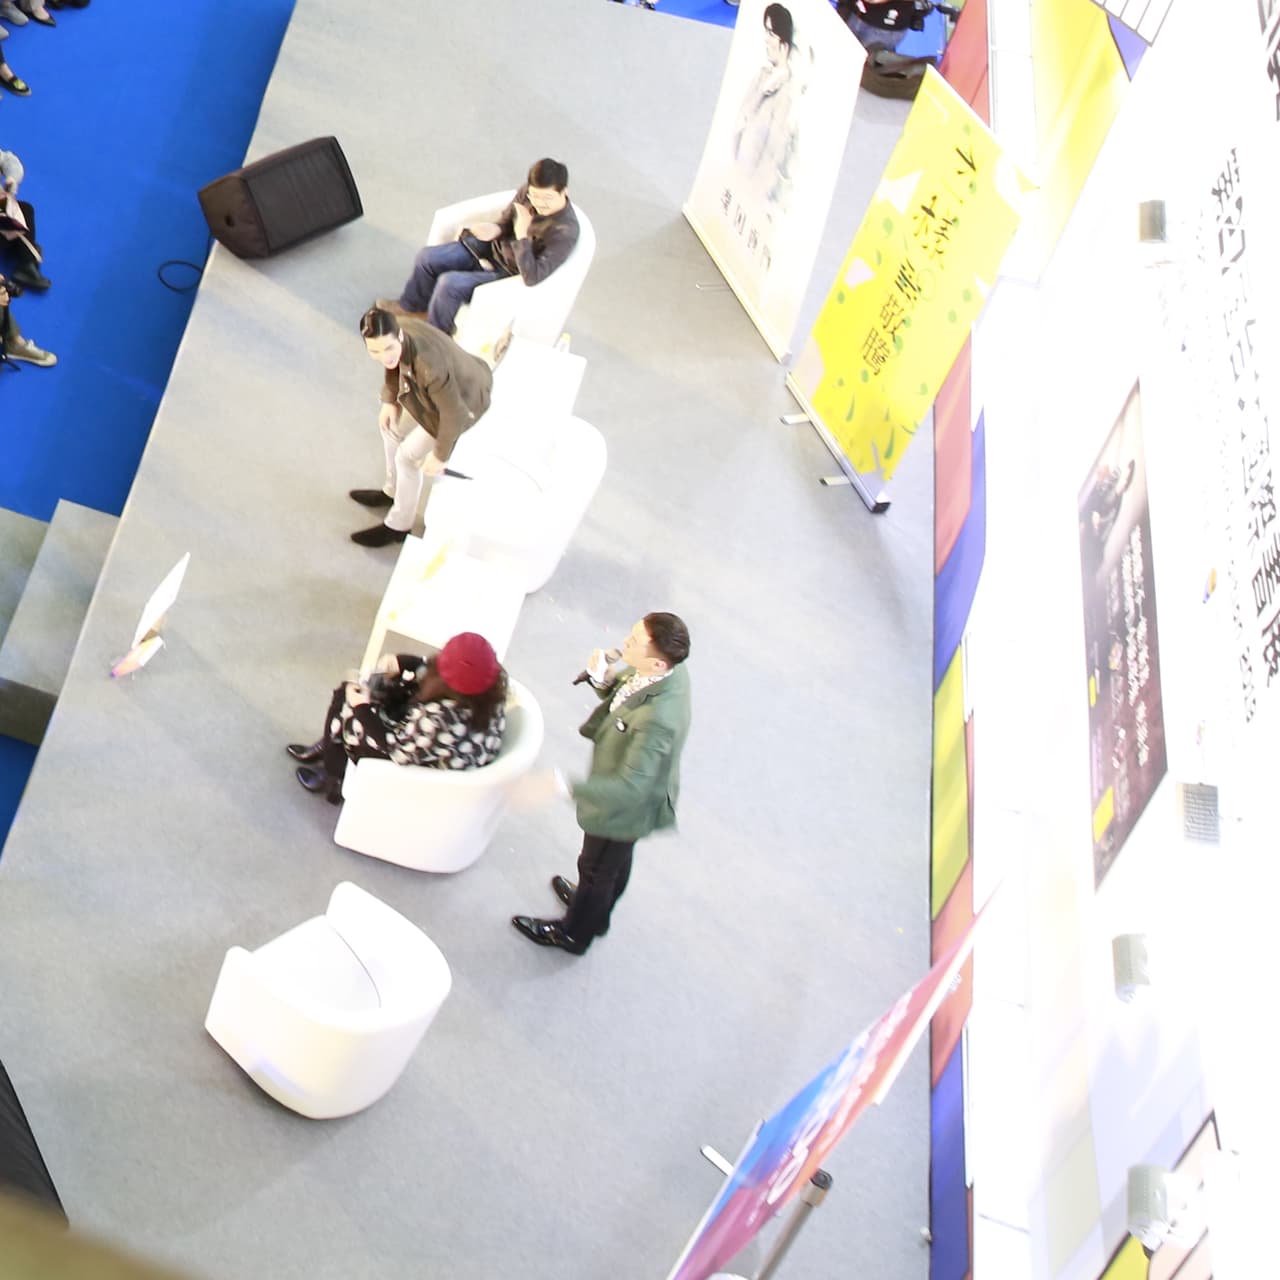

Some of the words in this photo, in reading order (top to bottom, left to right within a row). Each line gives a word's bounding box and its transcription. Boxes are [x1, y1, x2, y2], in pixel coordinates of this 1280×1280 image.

[1211, 146, 1280, 689] 第27台國際書展
